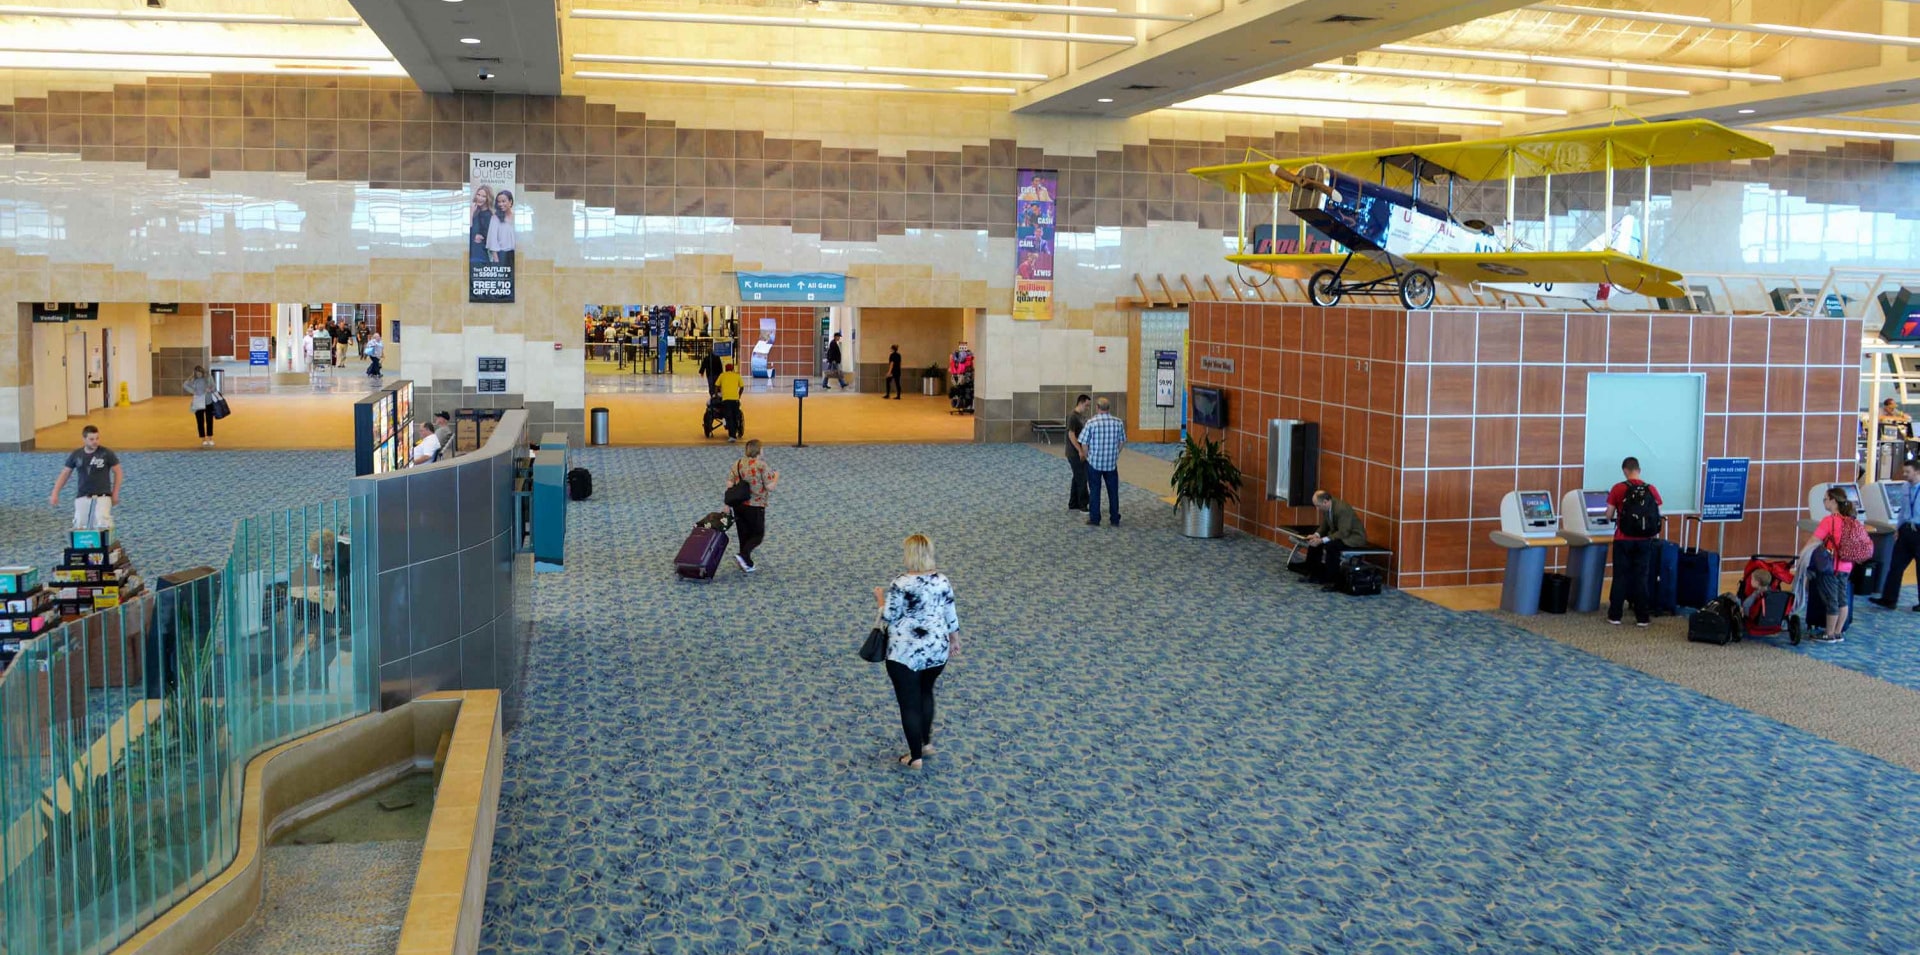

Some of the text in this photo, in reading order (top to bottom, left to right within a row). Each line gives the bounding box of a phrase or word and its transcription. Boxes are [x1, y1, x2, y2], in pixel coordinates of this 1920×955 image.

[473, 158, 513, 170] Tanger
[472, 168, 513, 179] Outlets
[1037, 217, 1053, 225] CASH
[1019, 240, 1035, 248] CARL
[1033, 269, 1052, 277] LEWIS
[473, 280, 511, 289] FREE $10
[754, 281, 790, 289] Restaurant
[818, 282, 837, 290] Gates
[1018, 283, 1046, 291] million
[489, 288, 511, 296] CARD
[1016, 295, 1046, 303] quartet
